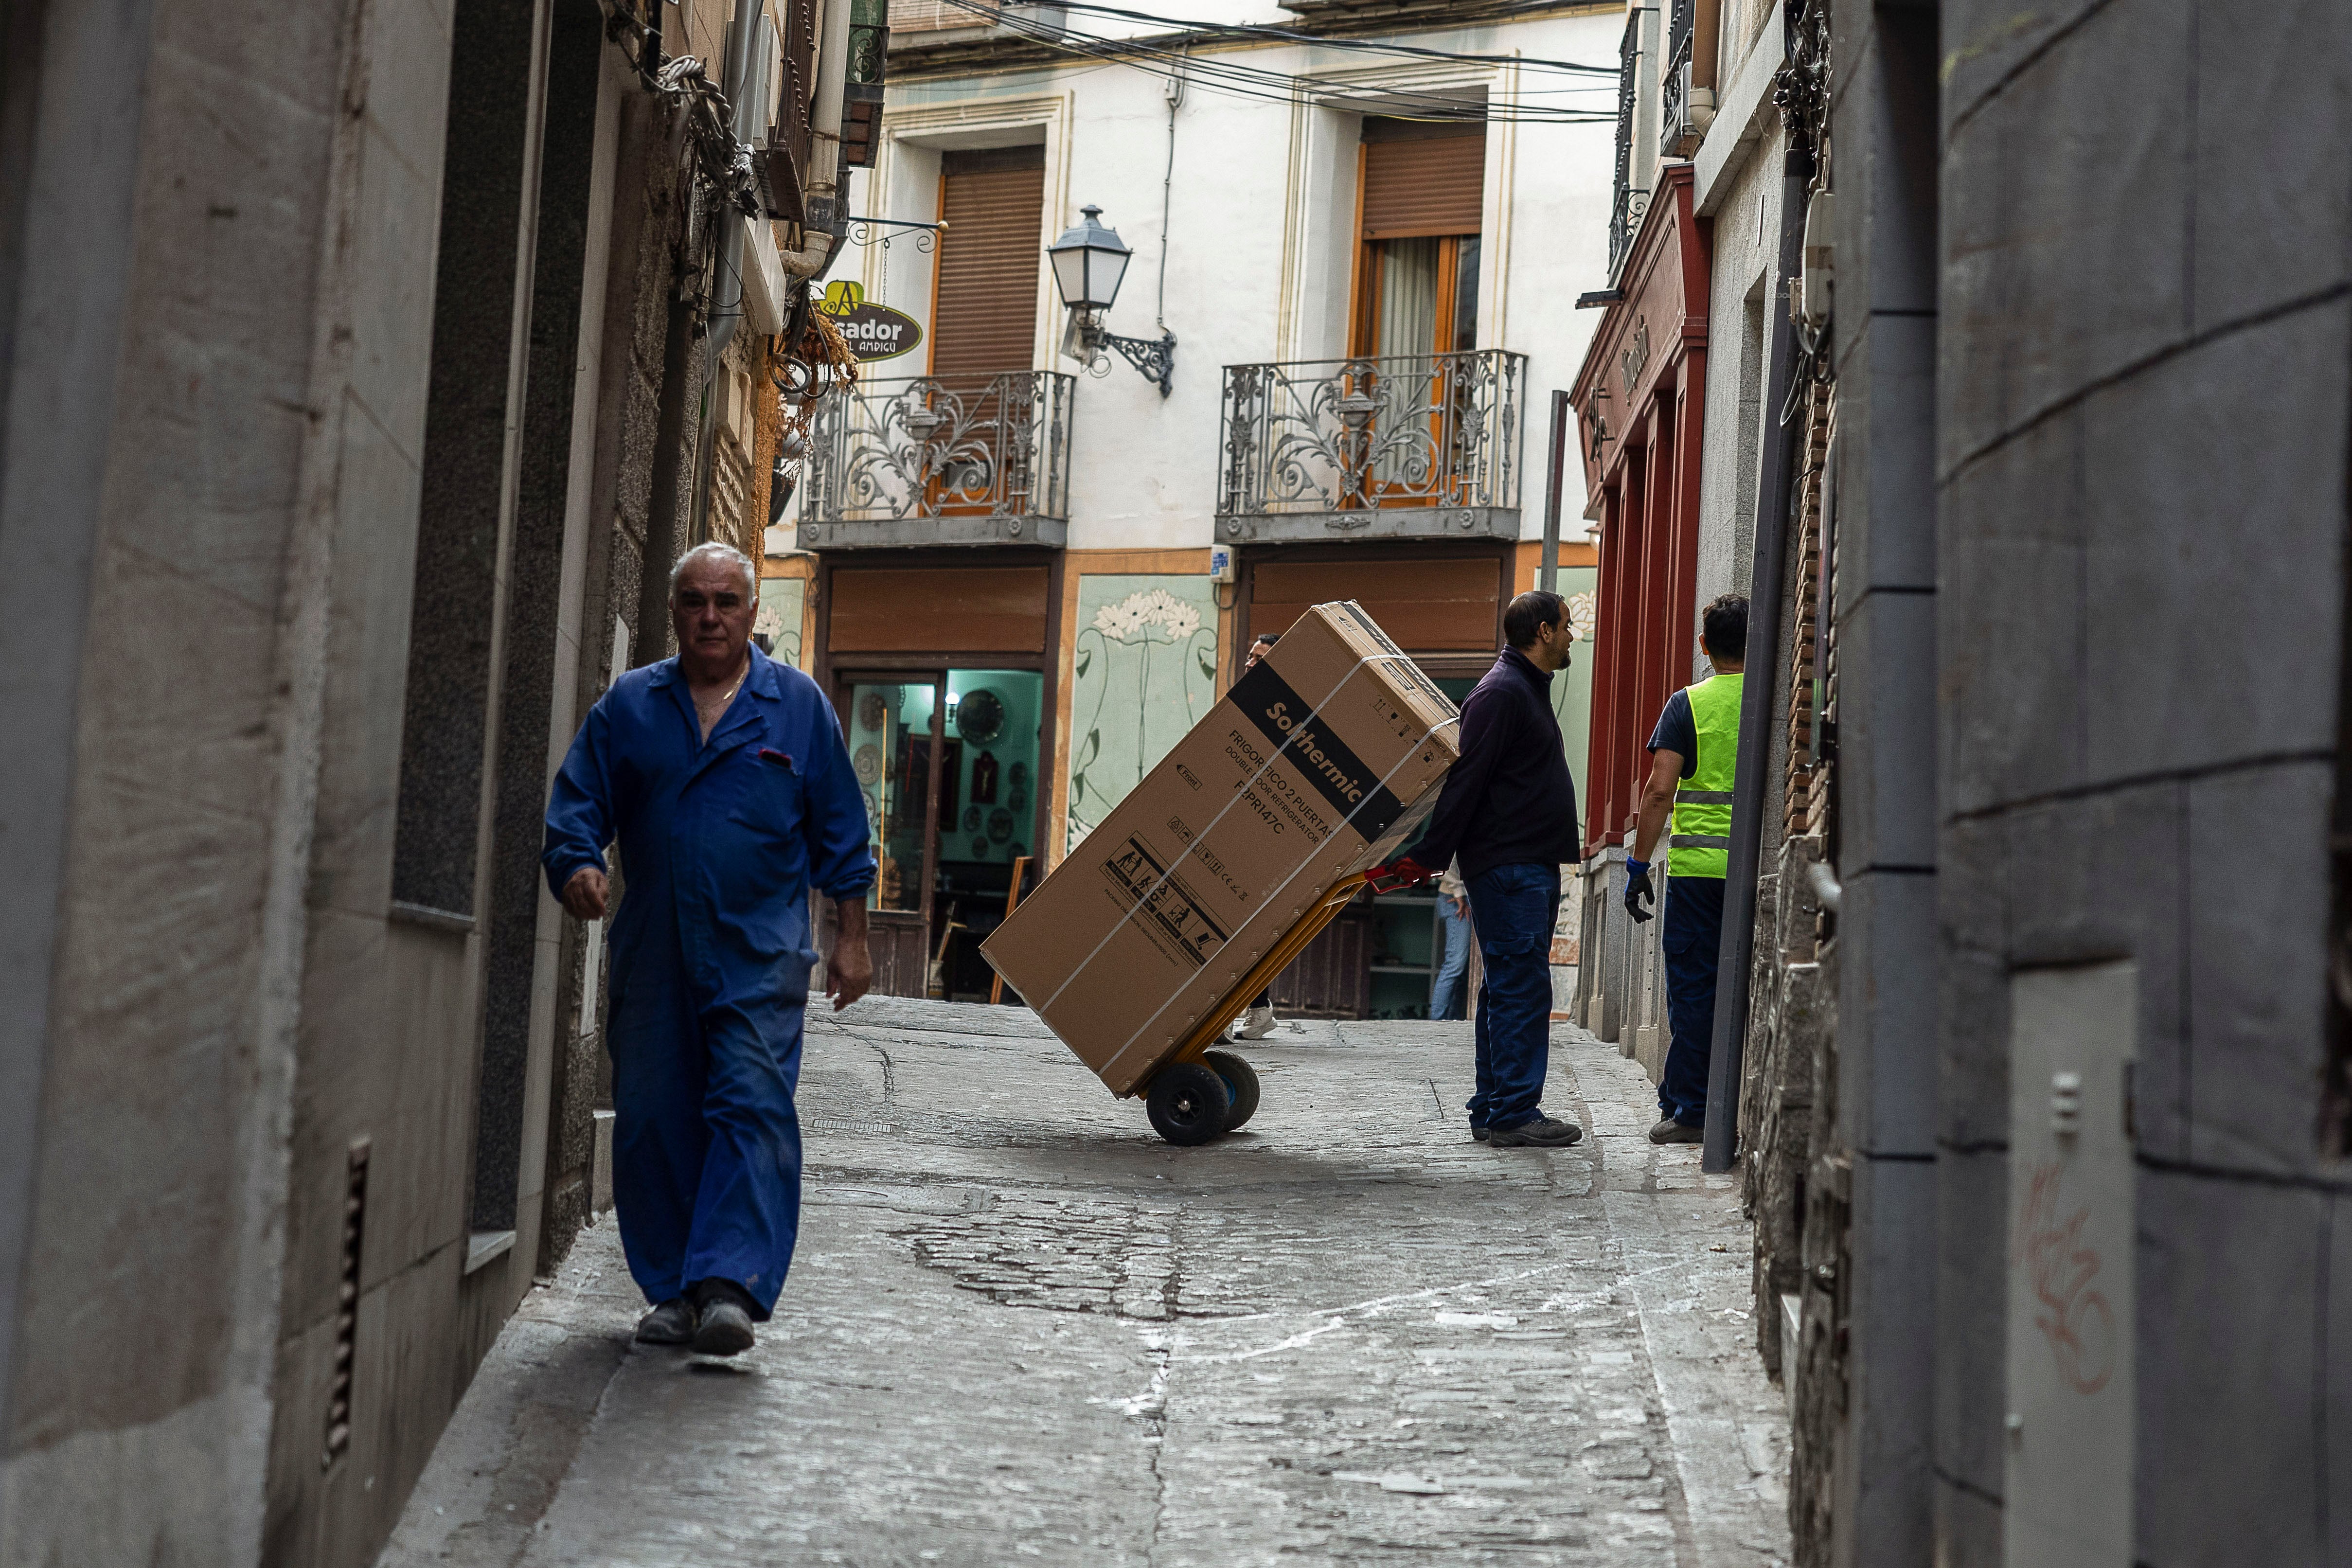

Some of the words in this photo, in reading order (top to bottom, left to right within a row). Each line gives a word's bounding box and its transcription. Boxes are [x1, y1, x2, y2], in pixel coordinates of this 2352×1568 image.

[836, 319, 902, 340] sador
[1181, 769, 1198, 787] Front
[1228, 729, 1288, 792] FRIGORFICO
[1284, 787, 1296, 800] 2
[1265, 704, 1362, 804] Solthermic
[1224, 745, 1253, 775] DOUBLE
[1269, 792, 1320, 845] REFRIGERATOR
[1232, 779, 1287, 836] F2PR147C
[1104, 888, 1122, 907] PACKING
[1120, 905, 1141, 928] DIMNSION:
[1137, 905, 1155, 923] uggested
